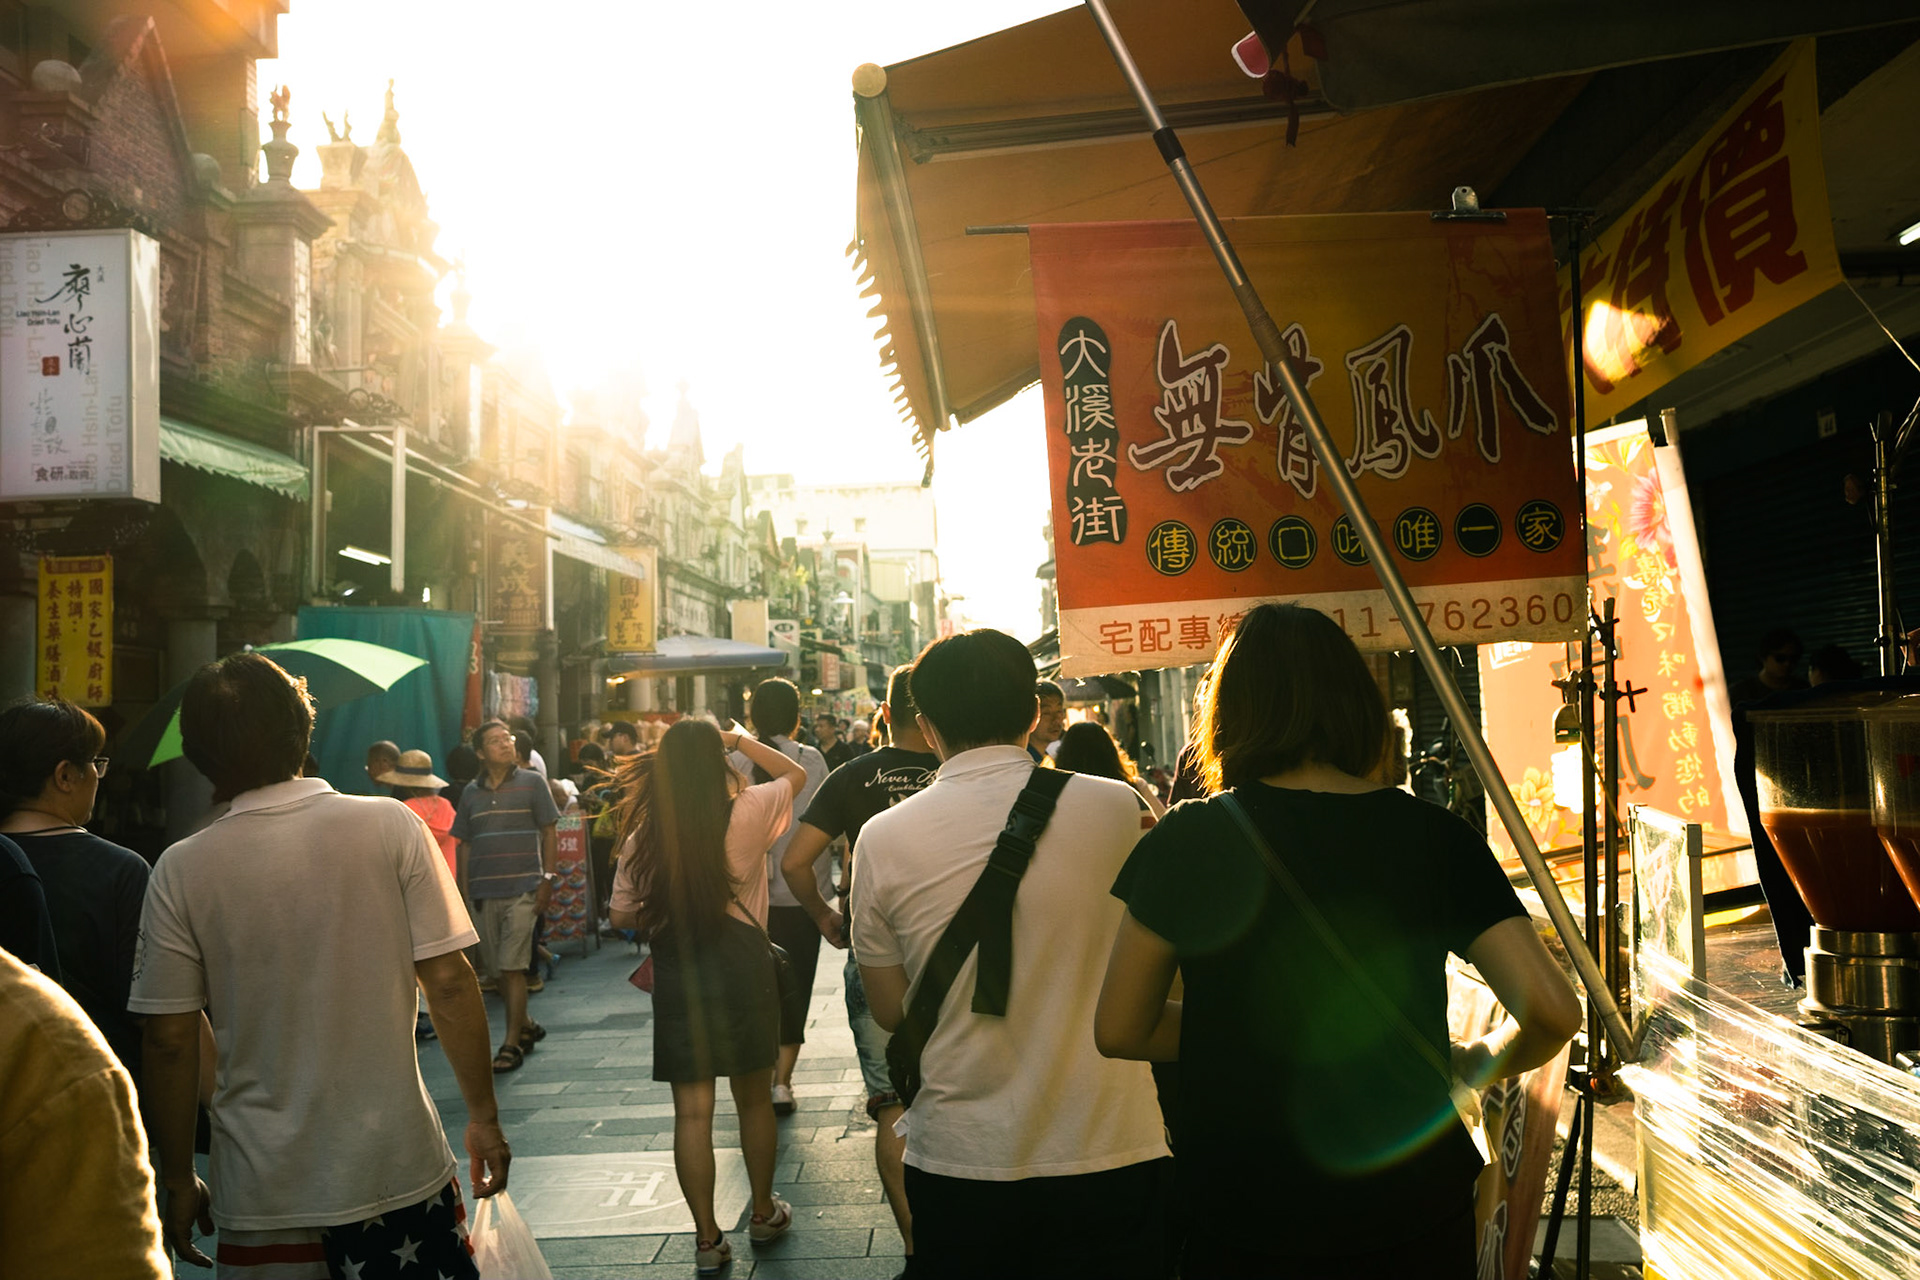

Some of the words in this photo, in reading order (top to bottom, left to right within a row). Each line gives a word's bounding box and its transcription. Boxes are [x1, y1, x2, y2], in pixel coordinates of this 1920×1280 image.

[1060, 329, 1123, 546] 大溪老街
[1128, 312, 1558, 500] 無骨鳳爪
[1148, 500, 1562, 574] 傳統口味唯一家
[865, 767, 911, 788] Never
